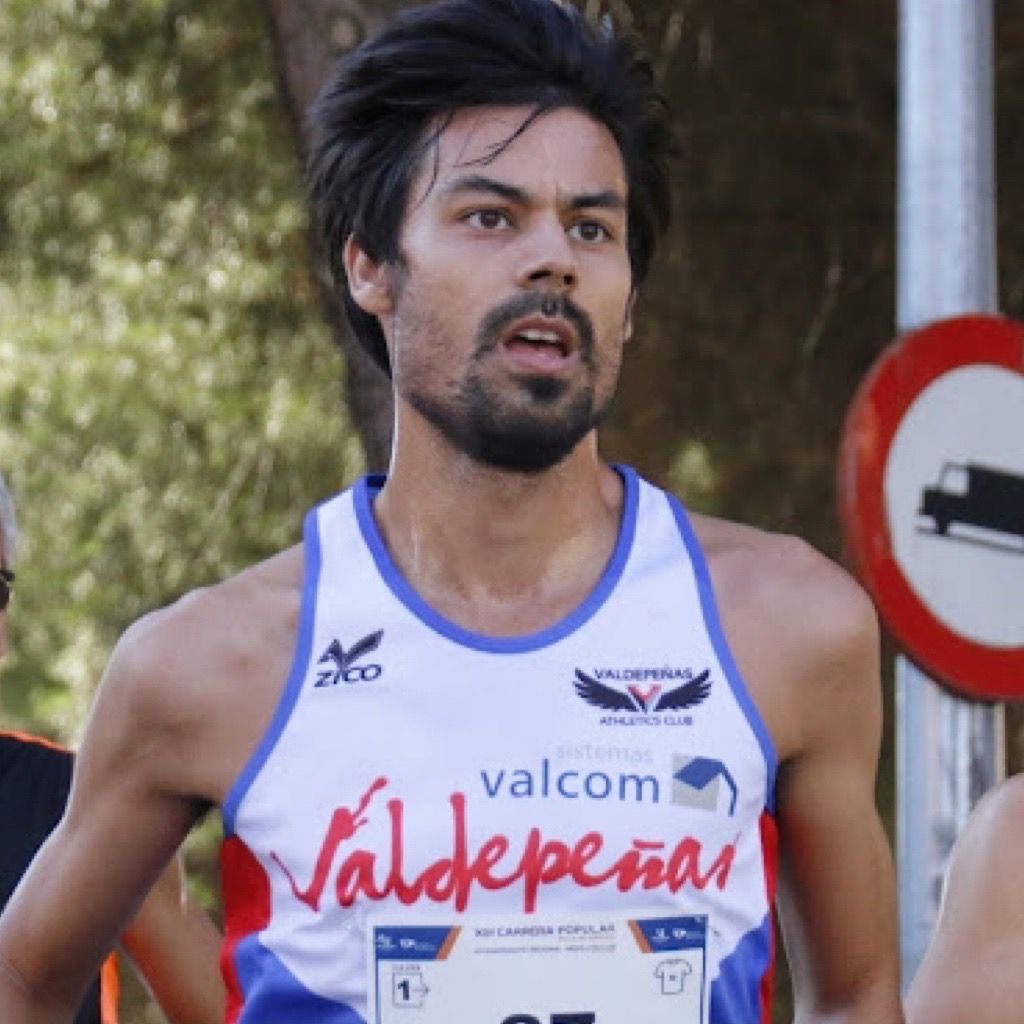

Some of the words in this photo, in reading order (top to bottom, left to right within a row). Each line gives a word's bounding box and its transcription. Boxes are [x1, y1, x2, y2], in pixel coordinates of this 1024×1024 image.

[314, 663, 383, 688] ZICO
[594, 665, 693, 681] VALDEPEÑAS
[599, 716, 661, 727] ATHLETICS
[664, 715, 693, 727] CLUB
[555, 742, 654, 763] sistemas
[480, 758, 661, 804] valcom
[397, 978, 410, 1000] 1
